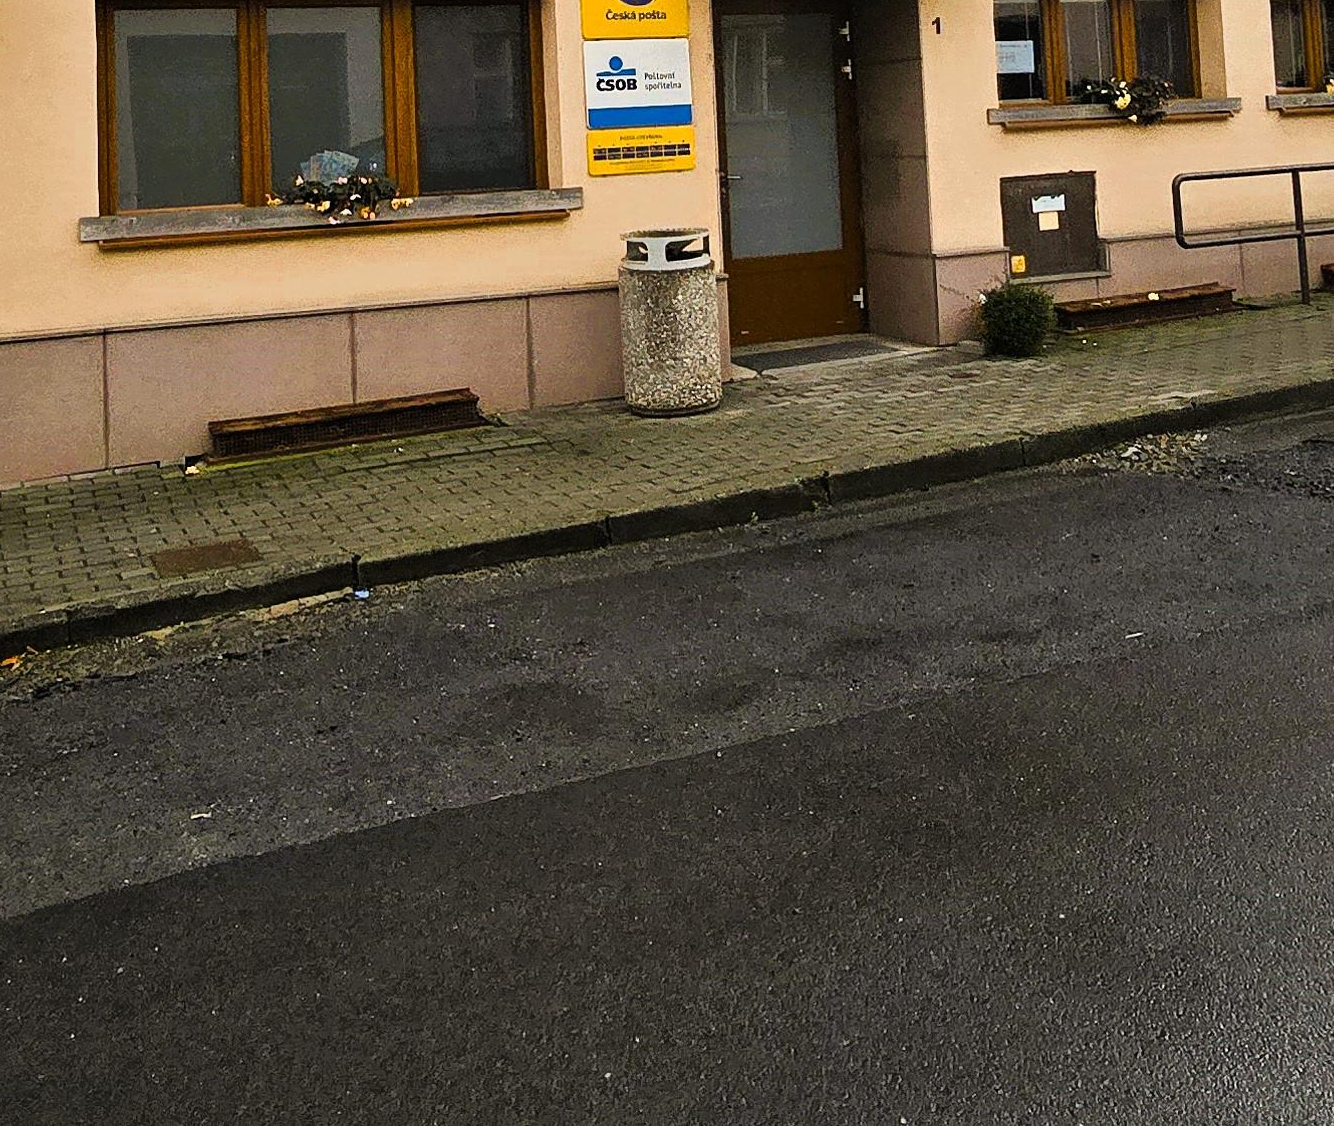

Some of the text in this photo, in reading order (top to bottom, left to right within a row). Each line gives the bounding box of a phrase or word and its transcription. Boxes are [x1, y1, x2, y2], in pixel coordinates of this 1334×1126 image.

[605, 8, 667, 22] Česká pošta
[931, 16, 941, 35] 1
[644, 71, 676, 80] Poštovní
[596, 77, 638, 92] ČSOB
[644, 80, 682, 92] spořitelna
